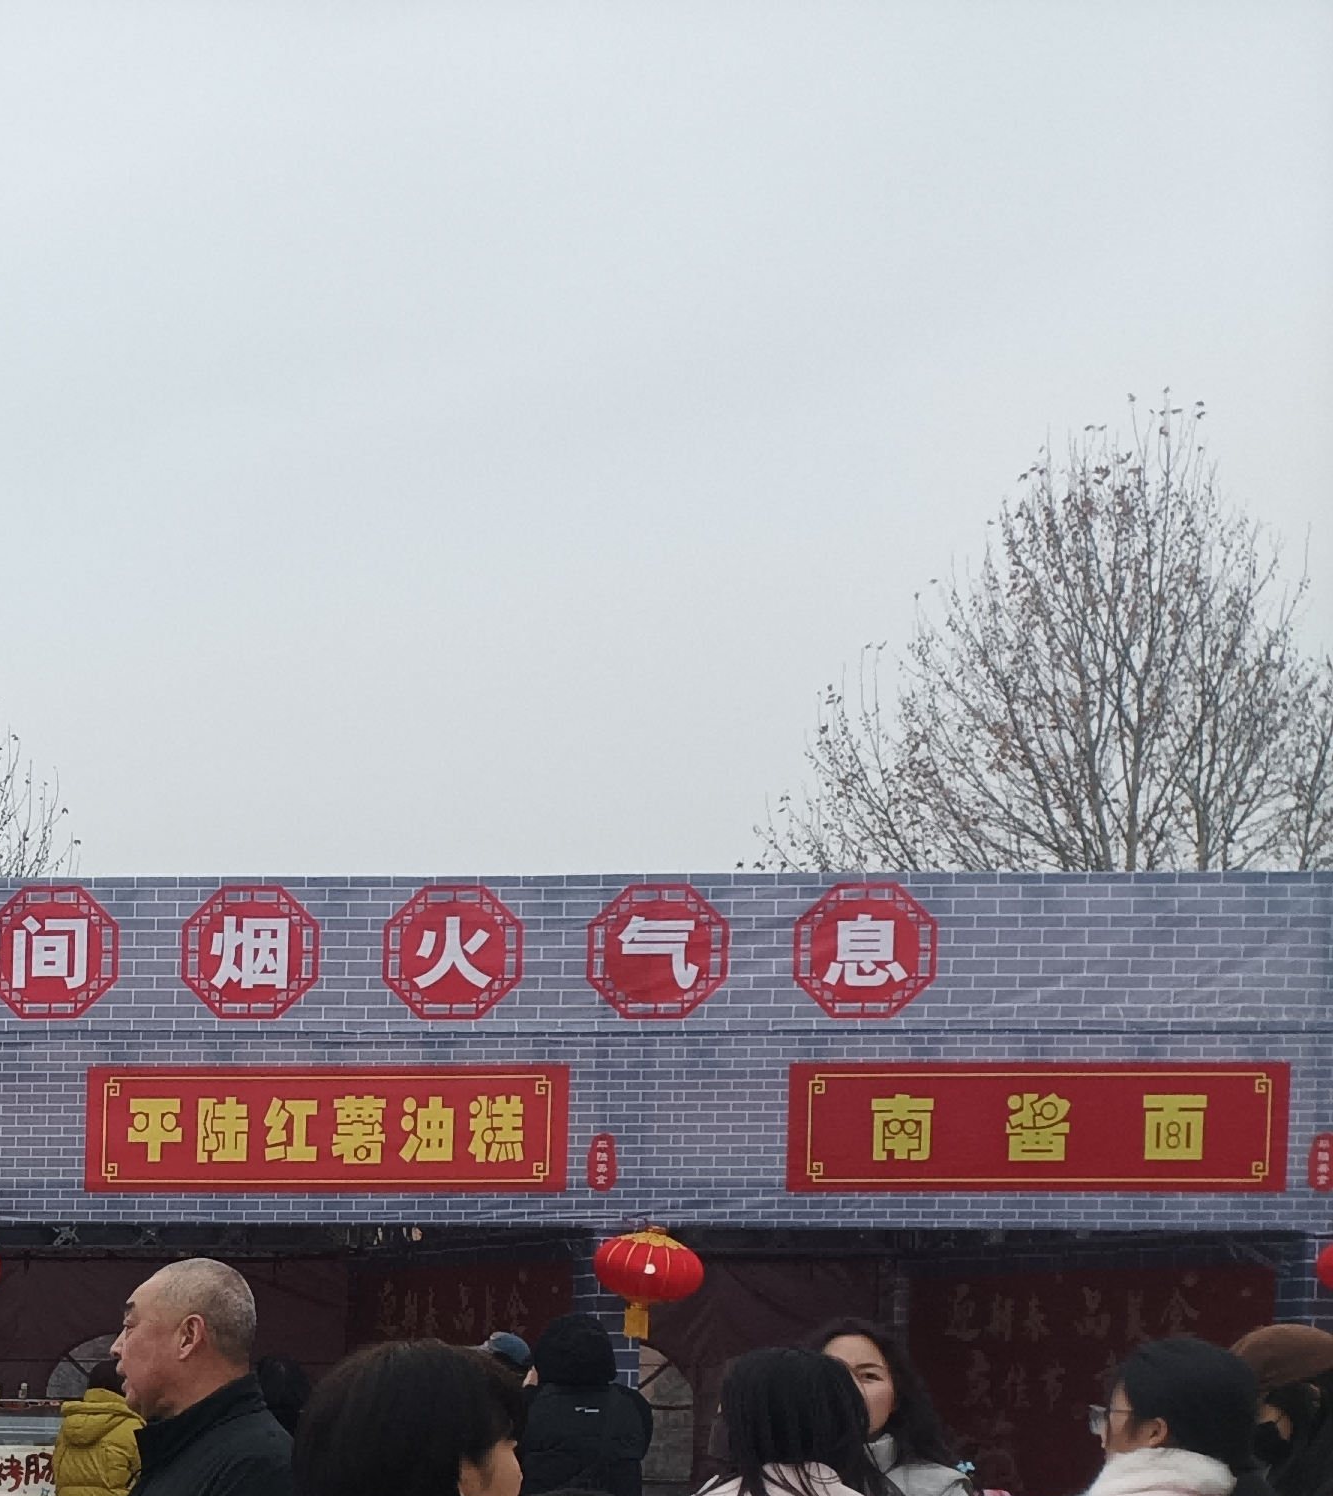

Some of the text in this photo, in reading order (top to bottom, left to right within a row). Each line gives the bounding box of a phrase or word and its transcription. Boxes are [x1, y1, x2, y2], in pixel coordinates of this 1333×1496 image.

[127, 1095, 524, 1163] 平陆红薯油糕
[870, 1093, 1208, 1161] 南酱面
